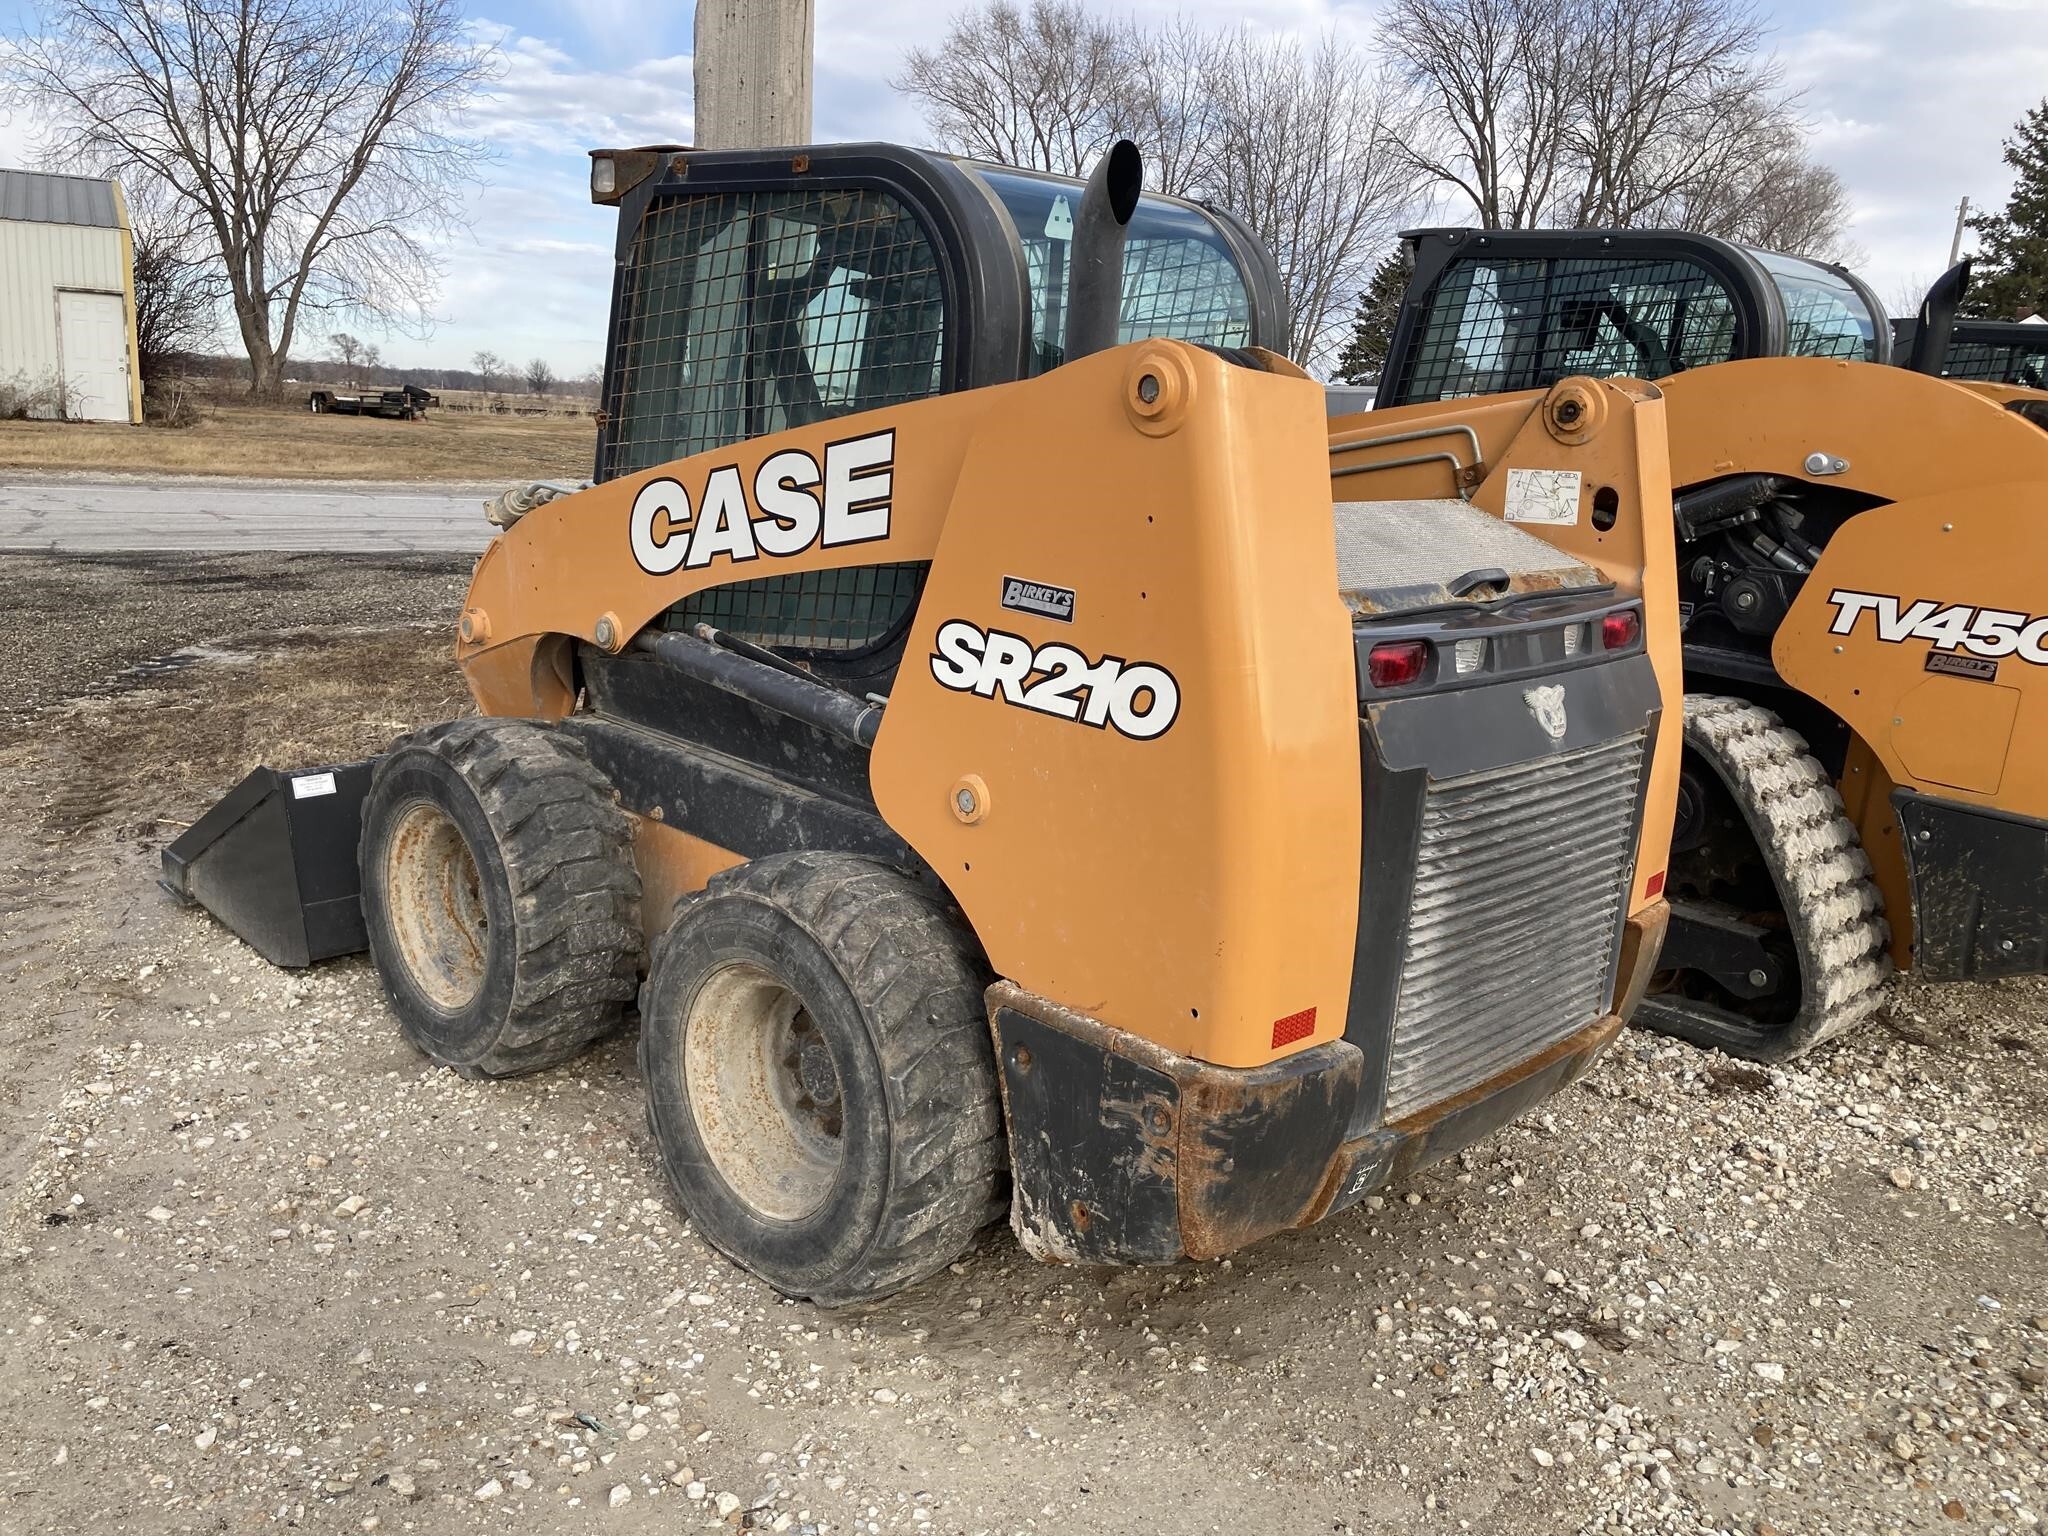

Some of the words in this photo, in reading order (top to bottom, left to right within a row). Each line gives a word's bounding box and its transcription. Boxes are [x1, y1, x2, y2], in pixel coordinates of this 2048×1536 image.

[628, 428, 897, 577] CASE
[1002, 580, 1074, 607] BIRKEY'S
[929, 618, 1182, 742] SR210
[1925, 654, 1997, 672] BIRKEY'S
